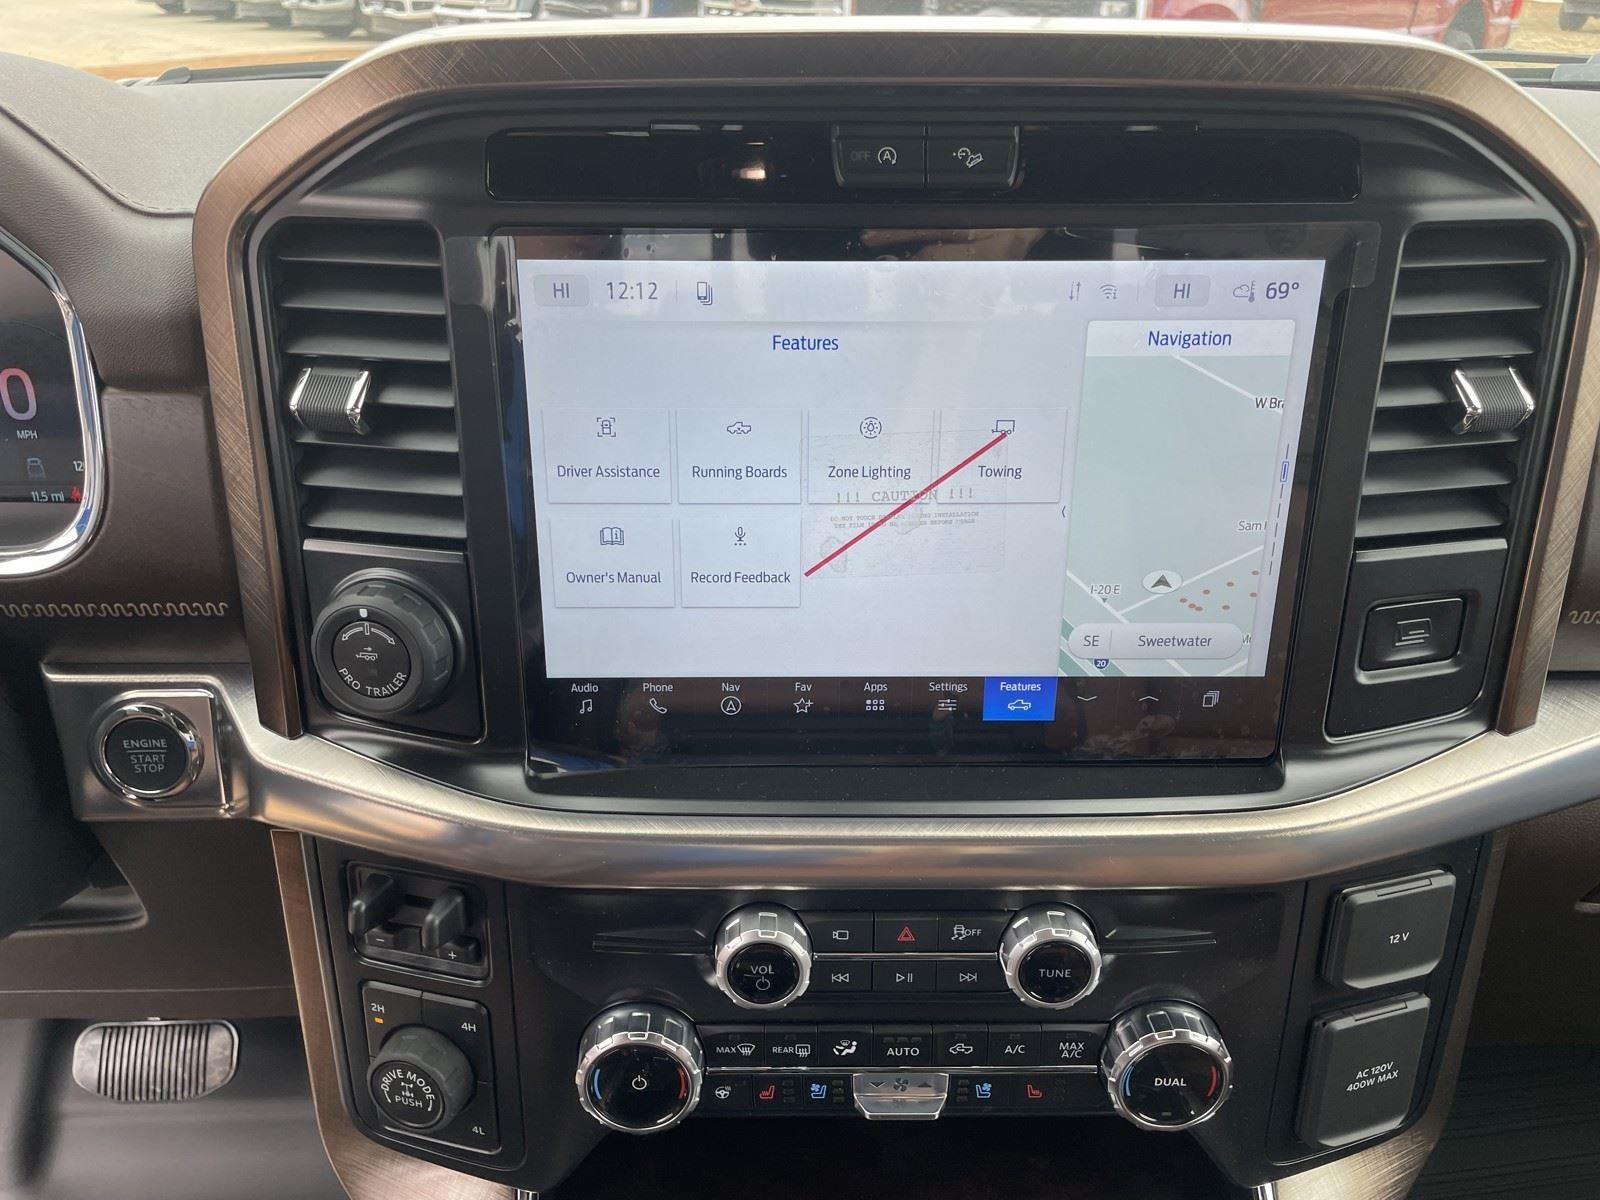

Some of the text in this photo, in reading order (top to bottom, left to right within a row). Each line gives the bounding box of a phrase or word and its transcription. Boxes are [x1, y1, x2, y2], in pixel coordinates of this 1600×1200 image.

[552, 282, 571, 300] HI
[605, 281, 659, 301] 12:12
[1173, 282, 1192, 300] HI
[771, 334, 840, 352] Features
[1147, 330, 1233, 349] Navigation
[0, 367, 38, 421] 0
[1255, 396, 1285, 409] W Br
[16, 429, 38, 440] MPH
[72, 460, 86, 472] 12
[556, 464, 661, 479] Driver Assistance
[691, 465, 788, 481] Running Boards
[827, 465, 912, 480] Zone Lighting
[977, 465, 1023, 480] Towing
[31, 490, 65, 502] 11.5 mi
[1237, 519, 1263, 532] Sam
[565, 571, 662, 584] Owner's Manual
[690, 571, 791, 584] Record Feedback
[1089, 584, 1121, 595] I-20 E
[1083, 634, 1213, 647] SE Sweetwater
[1096, 660, 1107, 668] 20
[338, 667, 407, 697] PRO TRAILER
[570, 682, 599, 693] Audio
[642, 682, 674, 692] Phone
[721, 682, 741, 692] Nav
[794, 682, 813, 692] Fav
[863, 682, 889, 693] Apps
[928, 681, 969, 693] Settings
[1000, 681, 1042, 692] Features
[122, 738, 168, 749] ENGINE
[130, 754, 166, 764] START
[134, 763, 165, 774] STOP
[965, 928, 983, 937] OFF
[1388, 931, 1411, 945] 12 V
[750, 963, 776, 975] VOL
[1038, 968, 1073, 978] TUNE
[370, 1002, 386, 1014] 2H
[461, 1021, 477, 1033] 4H
[715, 1045, 737, 1055] MAX
[772, 1045, 795, 1055] REAR
[886, 1046, 920, 1057] AUTO
[1004, 1044, 1026, 1055] A/C
[1058, 1041, 1086, 1051] MAX
[1060, 1050, 1083, 1059] A/C
[1355, 1061, 1394, 1080] AC 120V
[380, 1069, 436, 1101] DRIVE MODE
[1153, 1077, 1188, 1088] DUAL
[1346, 1069, 1399, 1092] 400W MAX
[394, 1095, 423, 1108] PUSH
[471, 1125, 486, 1136] 4L
